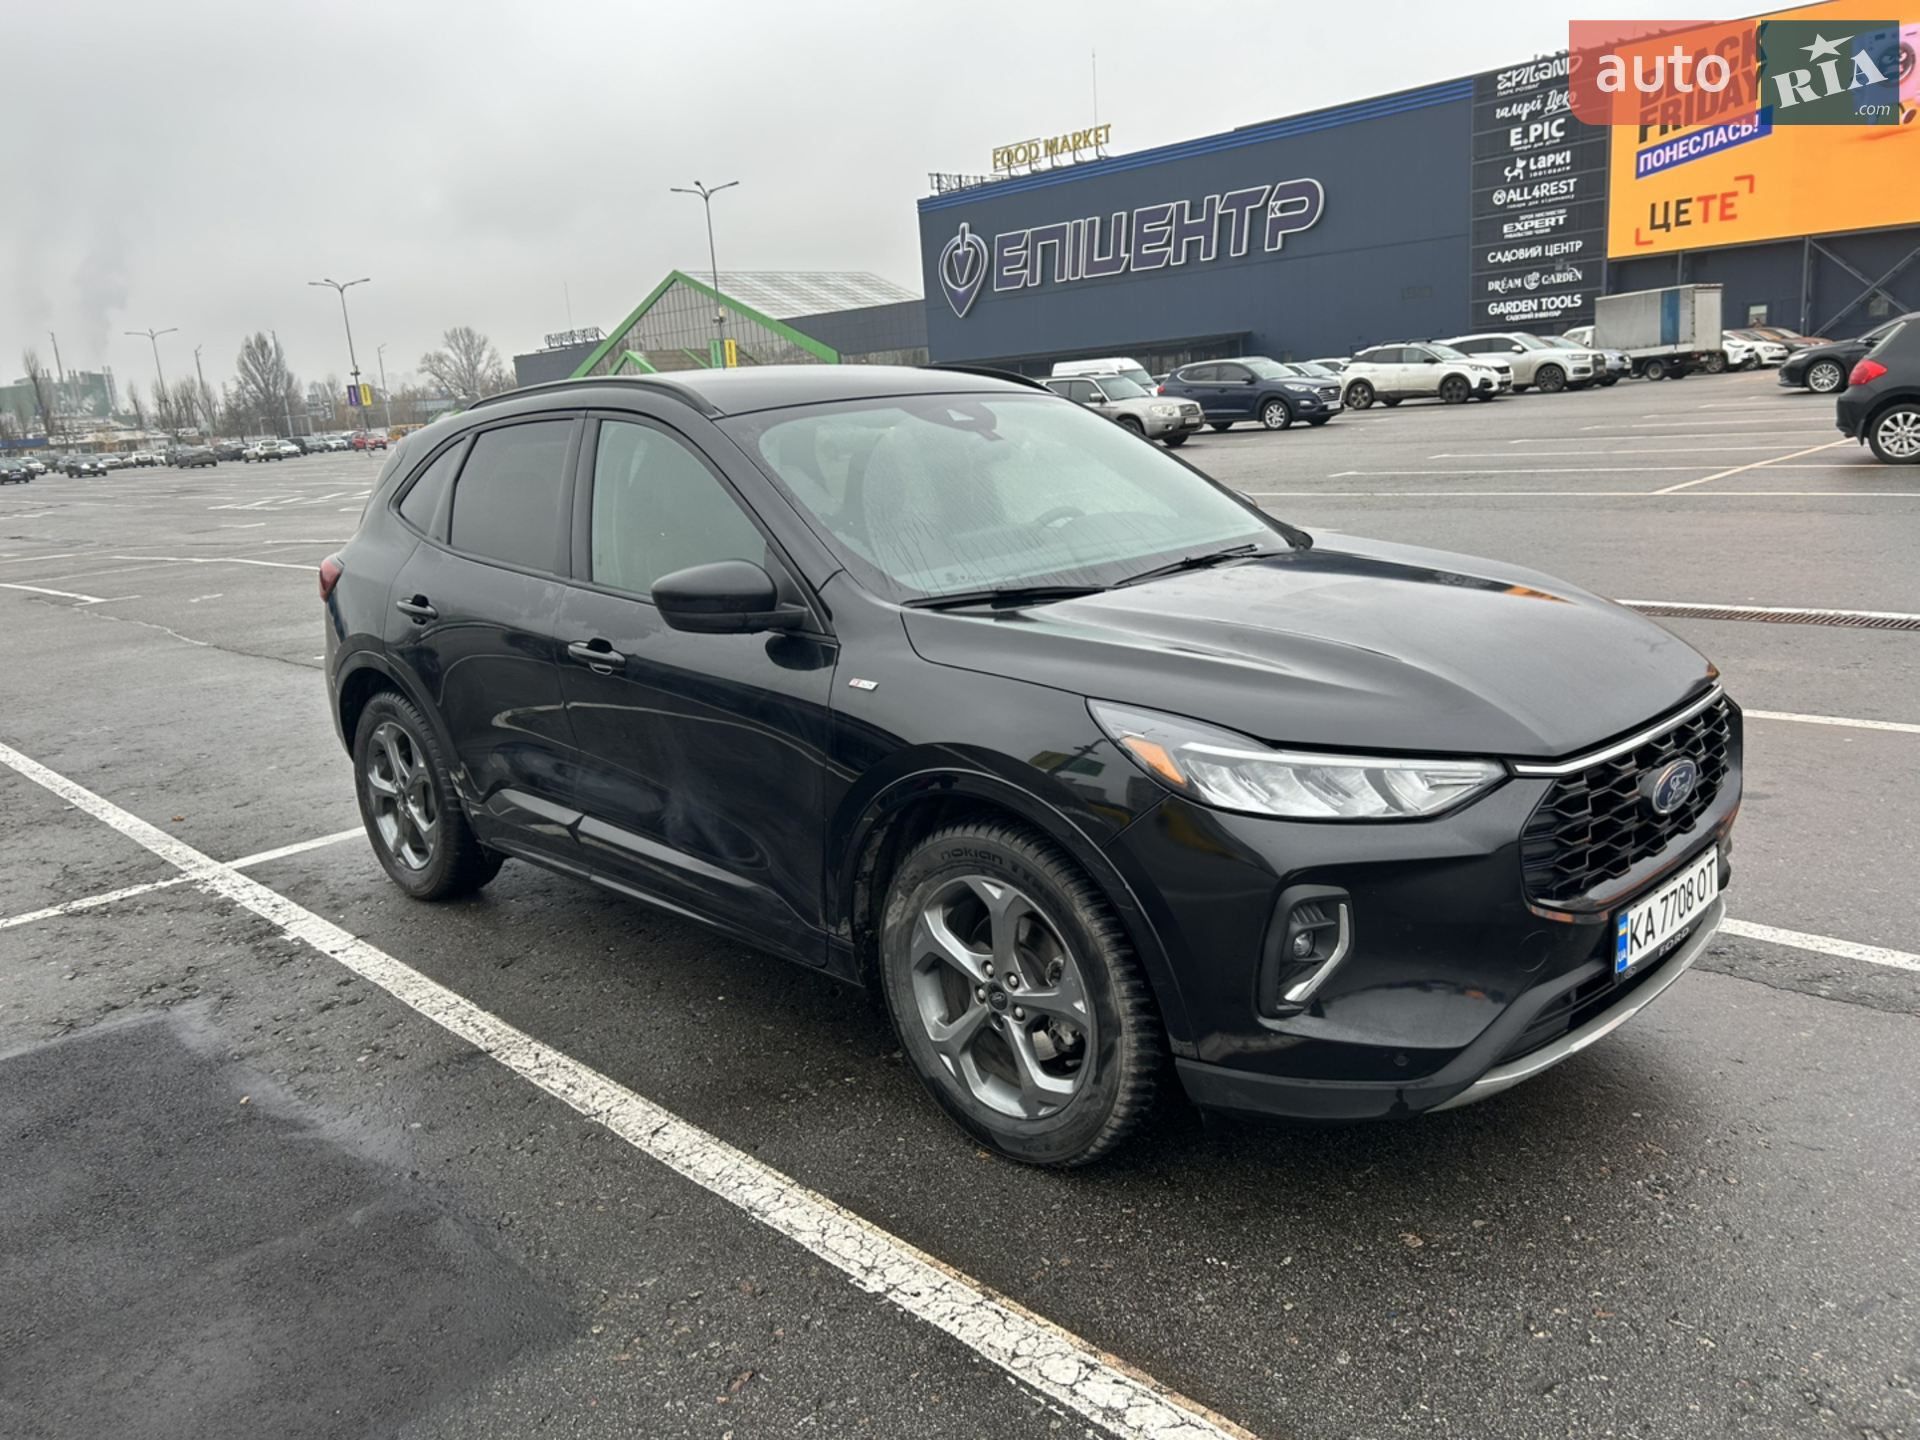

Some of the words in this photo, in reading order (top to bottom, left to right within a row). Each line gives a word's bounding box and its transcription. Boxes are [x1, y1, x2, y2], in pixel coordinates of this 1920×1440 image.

[1640, 21, 1769, 109] BLACK
[1638, 62, 1768, 144] FRIDAY
[992, 143, 1040, 169] FOOD
[1044, 124, 1111, 157] MARKET
[1509, 118, 1566, 147] E.PIC
[1638, 114, 1760, 173] ПОНЕСЛАСЬ!
[1506, 178, 1578, 203] ALL4REST
[1503, 214, 1567, 234] EXPERT
[1649, 191, 1739, 233] ЦЕТЕ
[993, 178, 1325, 291] ЕПІЦЕНТР
[1487, 245, 1542, 263] САДОВИЙ
[1545, 240, 1583, 257] ЦЕНТР
[1541, 267, 1583, 285] GARDEN
[1487, 299, 1538, 316] GARDEN
[1540, 294, 1582, 310] TOOLS
[1629, 906, 1656, 956] KA
[1660, 876, 1694, 935] 7708
[1697, 857, 1715, 903] OT
[1659, 926, 1690, 957] FORD
